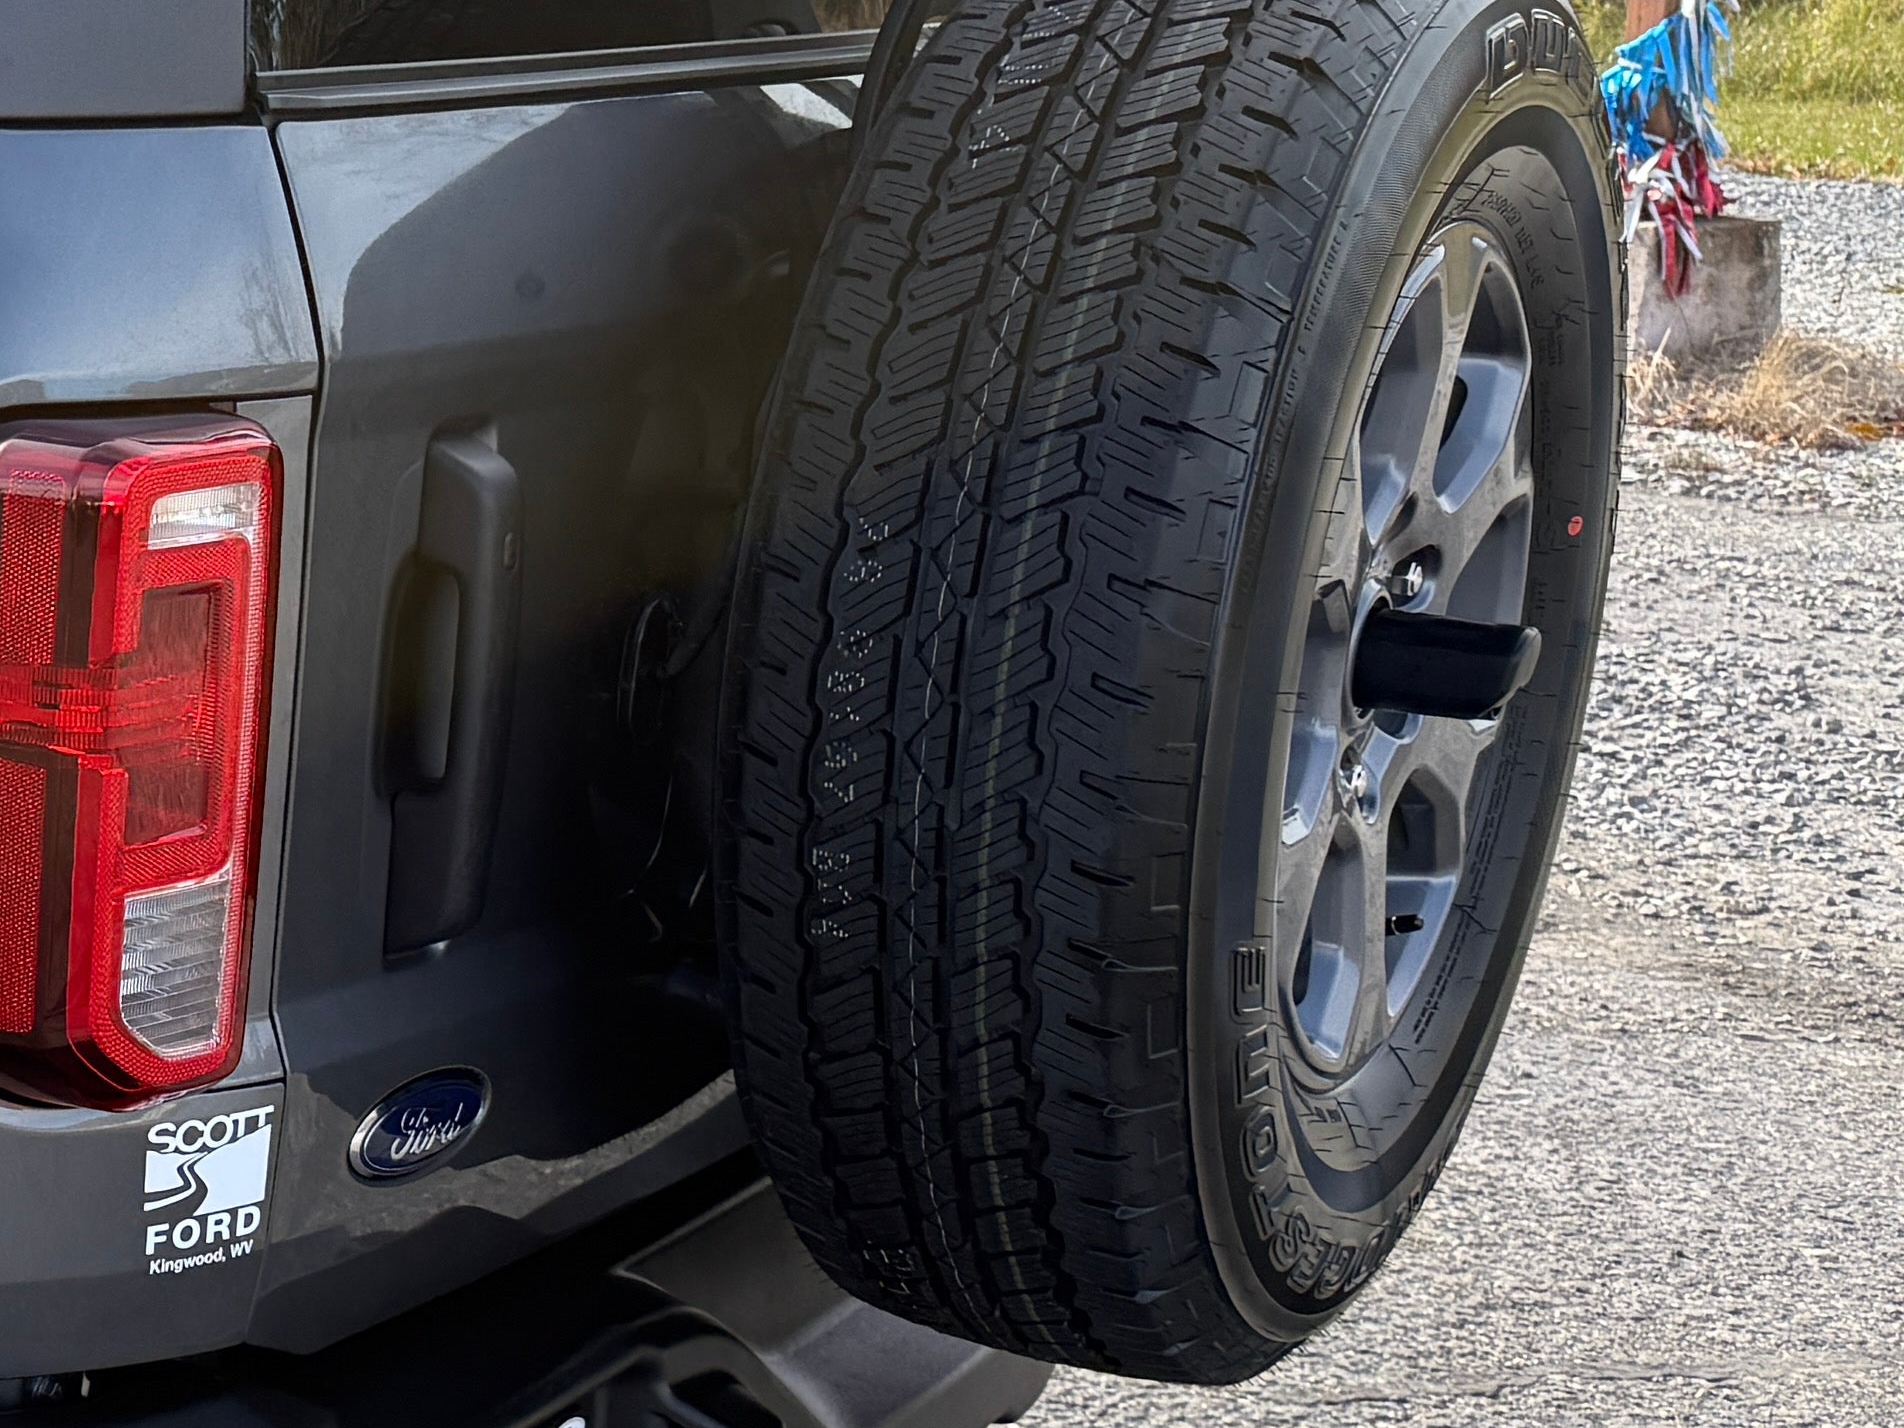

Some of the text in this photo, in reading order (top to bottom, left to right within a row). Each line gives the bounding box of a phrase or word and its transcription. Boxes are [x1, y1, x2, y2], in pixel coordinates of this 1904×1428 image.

[146, 1103, 275, 1154] SCOTT
[390, 1102, 464, 1161] Ford
[144, 1205, 262, 1256] FORD
[148, 1237, 255, 1276] Kingwood, WV
